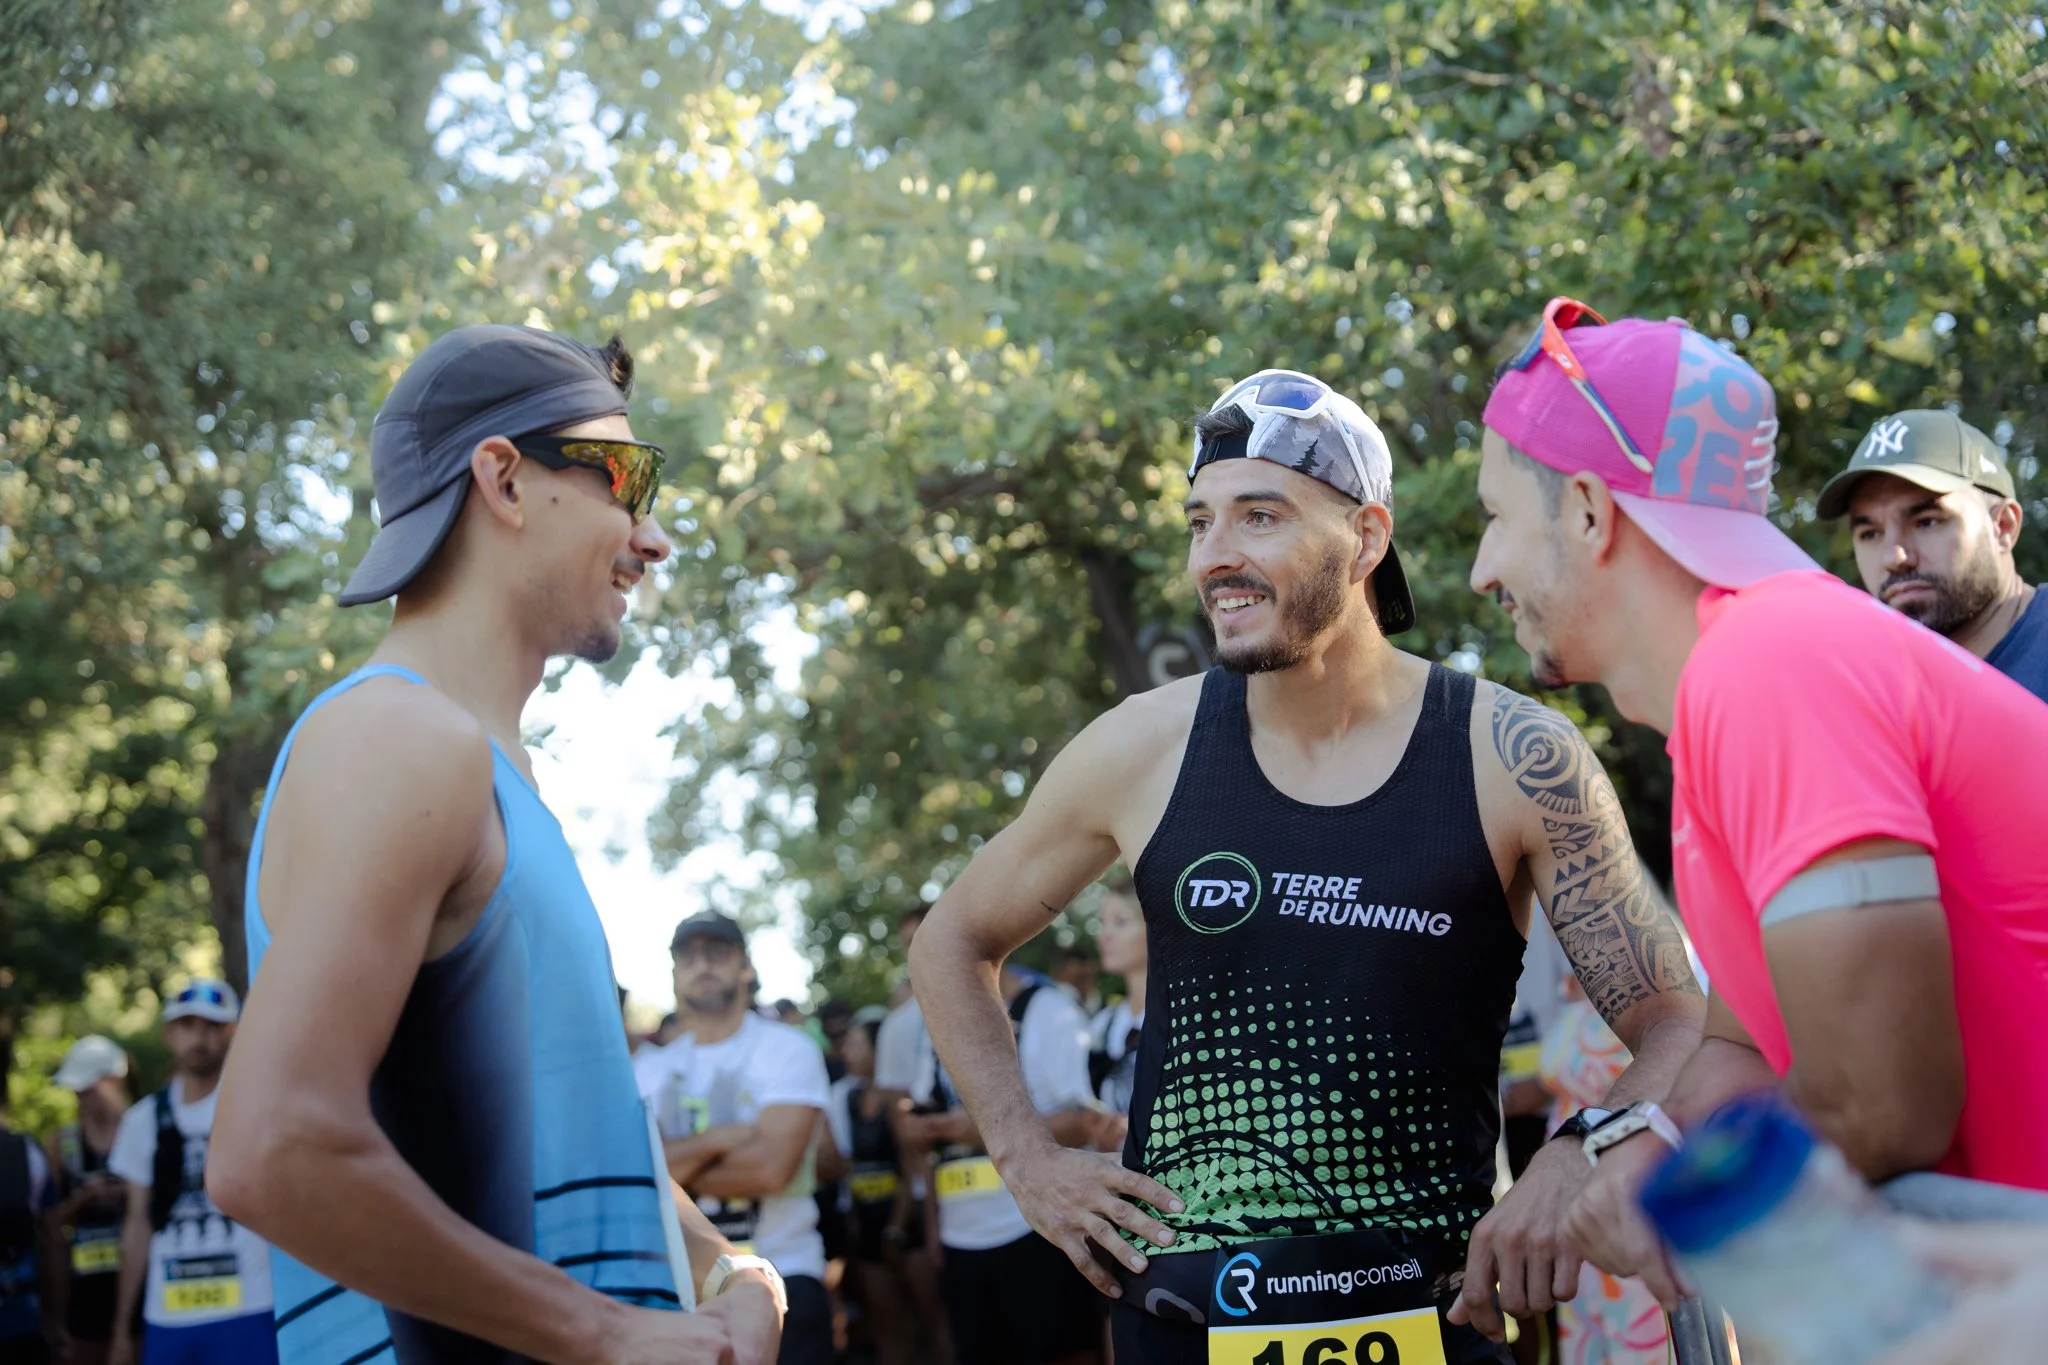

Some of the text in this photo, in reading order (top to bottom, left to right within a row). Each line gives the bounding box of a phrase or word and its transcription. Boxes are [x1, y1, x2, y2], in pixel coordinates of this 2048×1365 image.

[1864, 418, 1910, 459] NY
[1189, 879, 1250, 908] TDR
[1271, 872, 1362, 900] TERRE
[1308, 903, 1453, 937] RUNNING
[1266, 1258, 1423, 1295] runningconseil
